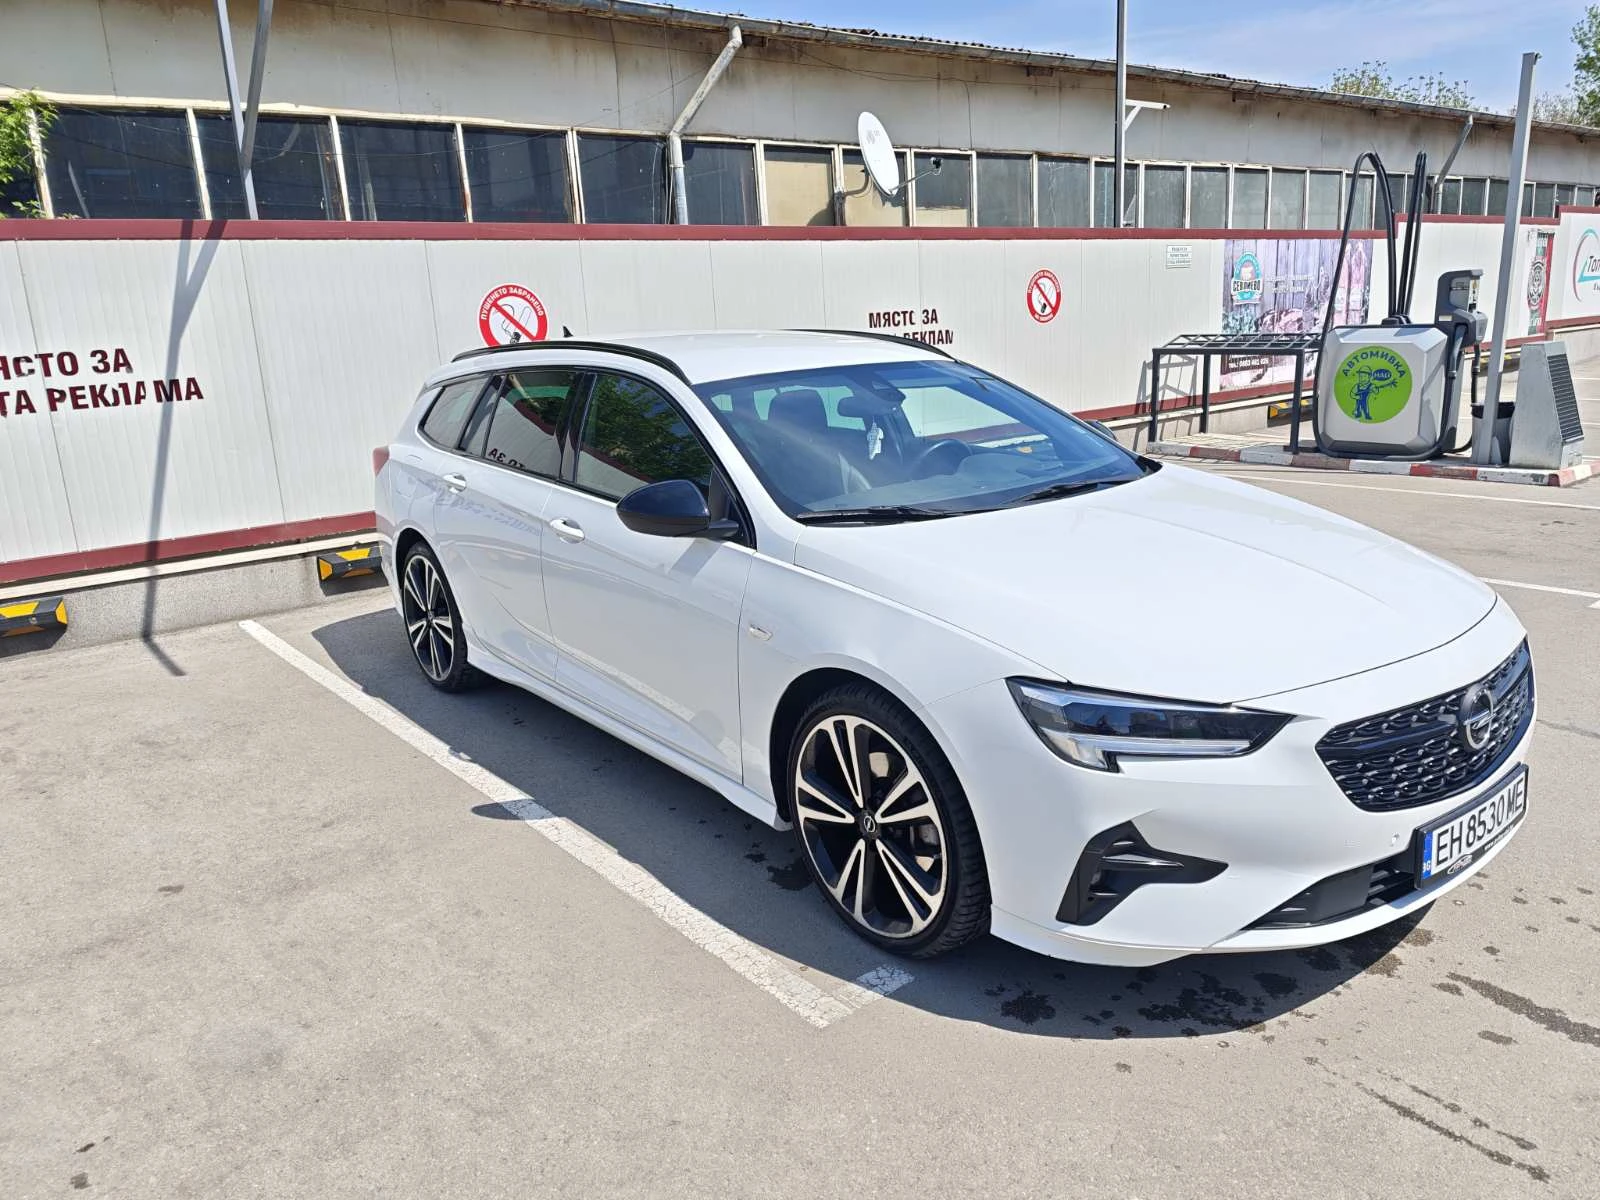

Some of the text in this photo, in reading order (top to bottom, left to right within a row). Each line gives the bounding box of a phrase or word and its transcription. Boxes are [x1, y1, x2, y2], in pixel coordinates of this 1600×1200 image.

[922, 308, 938, 325] ЗА
[90, 348, 133, 374] ЗА
[1342, 350, 1406, 378] АВТОМИВКА
[46, 377, 204, 412] РЕКЛАМА
[1437, 820, 1463, 865] EH
[1466, 794, 1505, 848] 8530
[1506, 777, 1524, 821] ME
